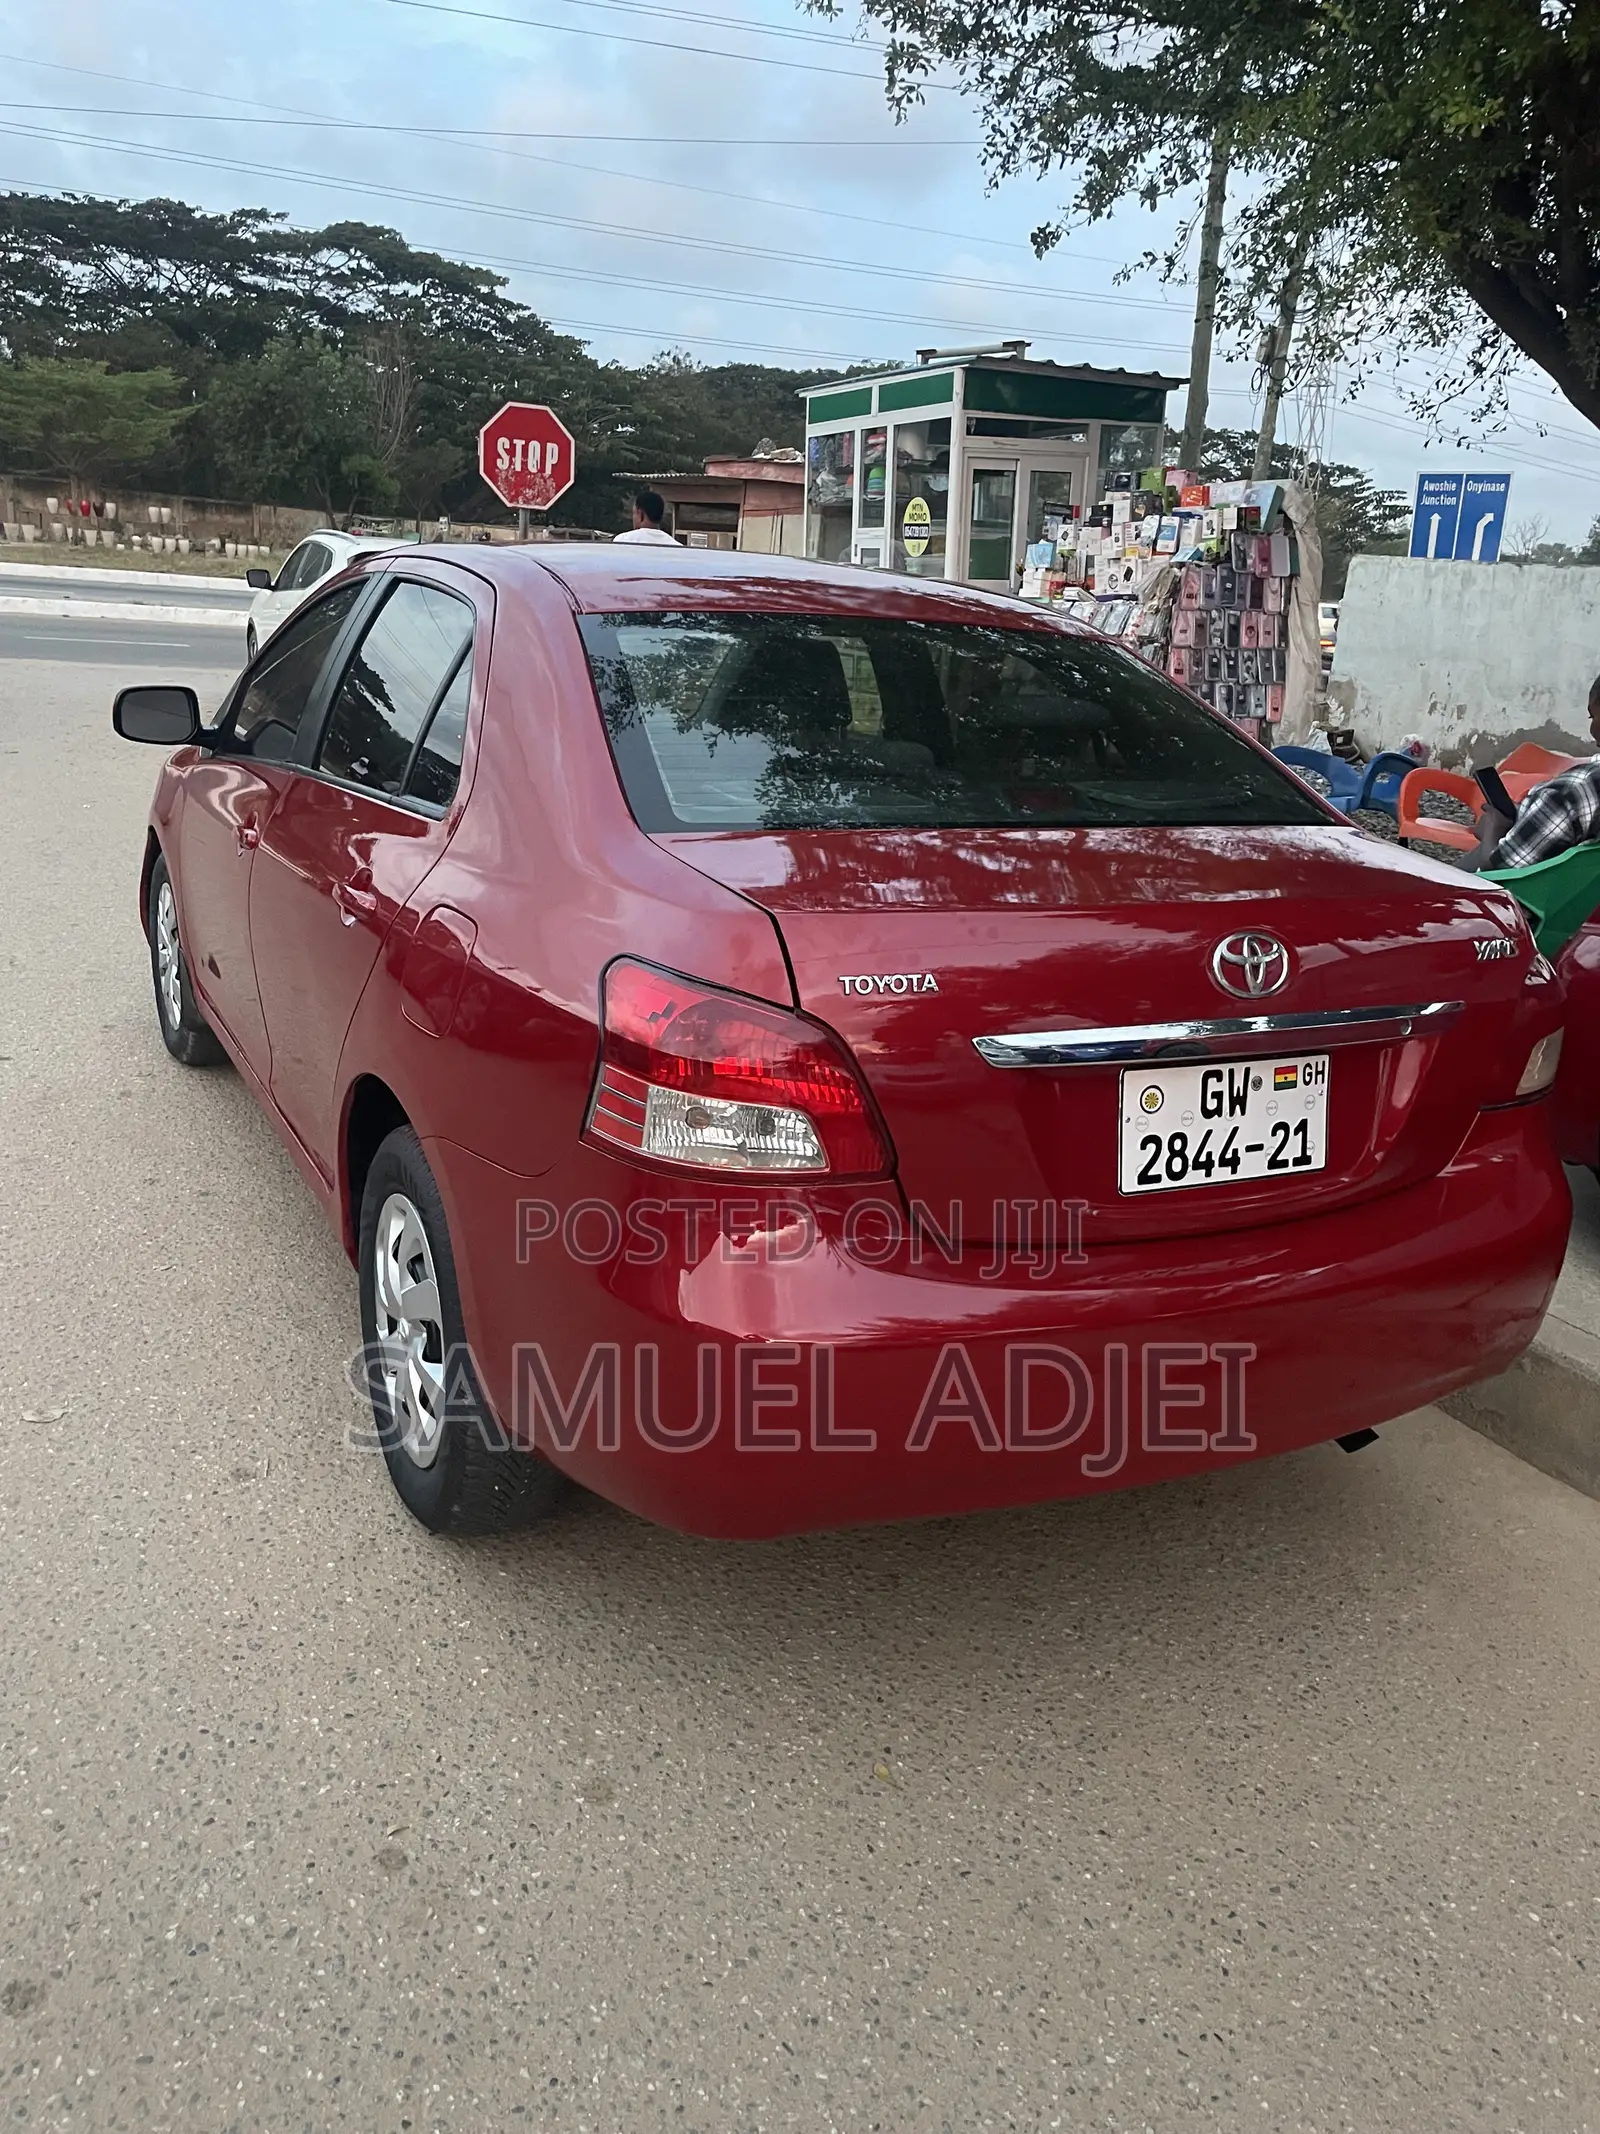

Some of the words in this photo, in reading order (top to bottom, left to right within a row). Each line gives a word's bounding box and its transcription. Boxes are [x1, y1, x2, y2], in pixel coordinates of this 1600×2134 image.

[496, 437, 559, 475] STOP
[1423, 480, 1457, 492] Awoshie
[1466, 480, 1506, 494] Onyinase
[1420, 494, 1457, 506] Junction
[908, 512, 927, 522] MOMO
[838, 973, 940, 996] TOYOTA
[1302, 1060, 1326, 1087] GH
[1200, 1066, 1251, 1120] GW
[1137, 1118, 1313, 1186] 2844-21
